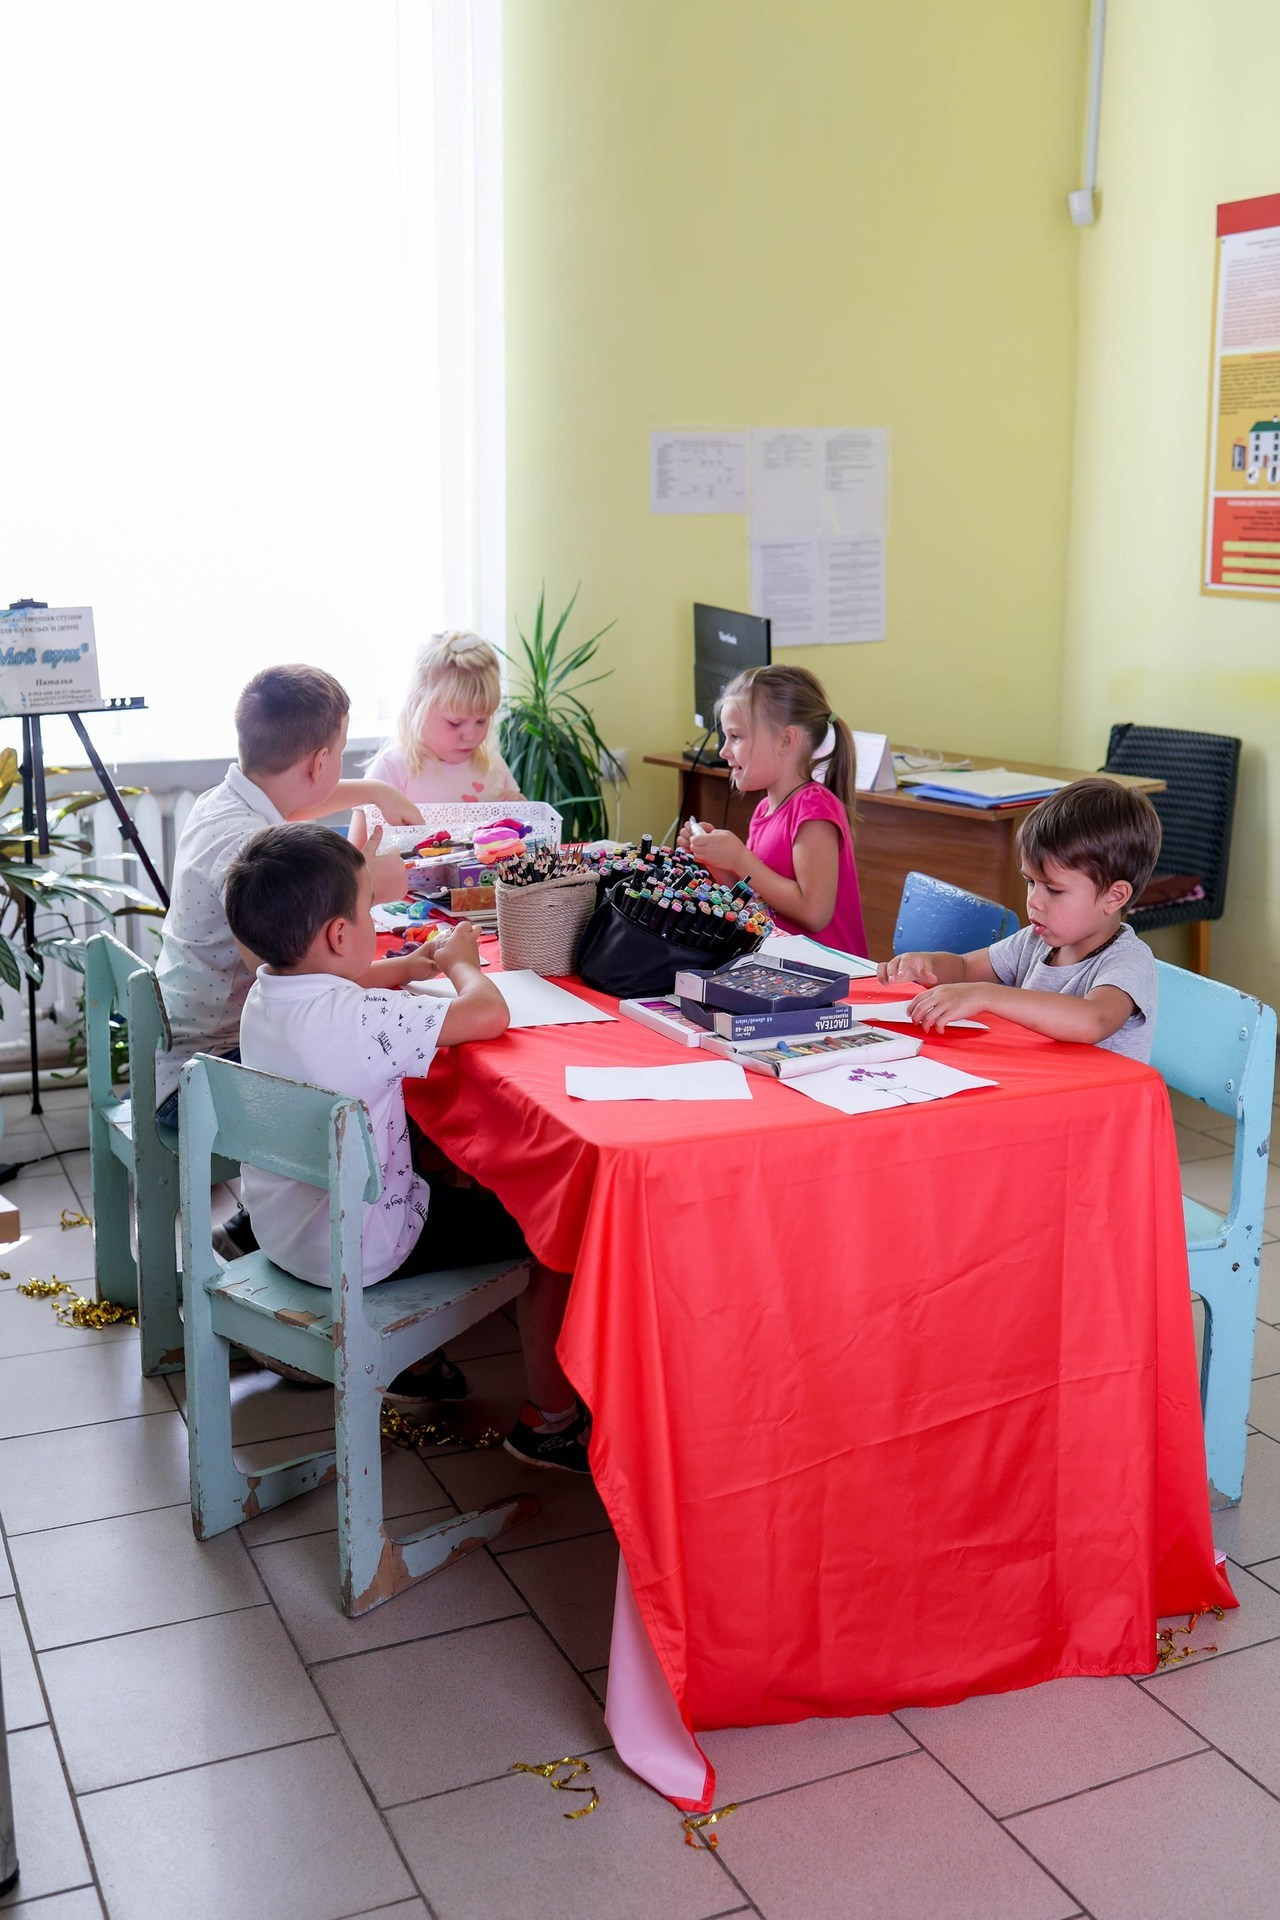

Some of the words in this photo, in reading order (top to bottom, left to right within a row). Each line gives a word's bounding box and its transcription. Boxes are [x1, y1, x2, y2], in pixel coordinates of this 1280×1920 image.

[56, 614, 82, 622] студия
[57, 624, 79, 632] детей
[35, 678, 74, 687] Наталья
[815, 1018, 849, 1030] ПАСТЕЛЬ
[735, 1025, 756, 1033] VASP-48
